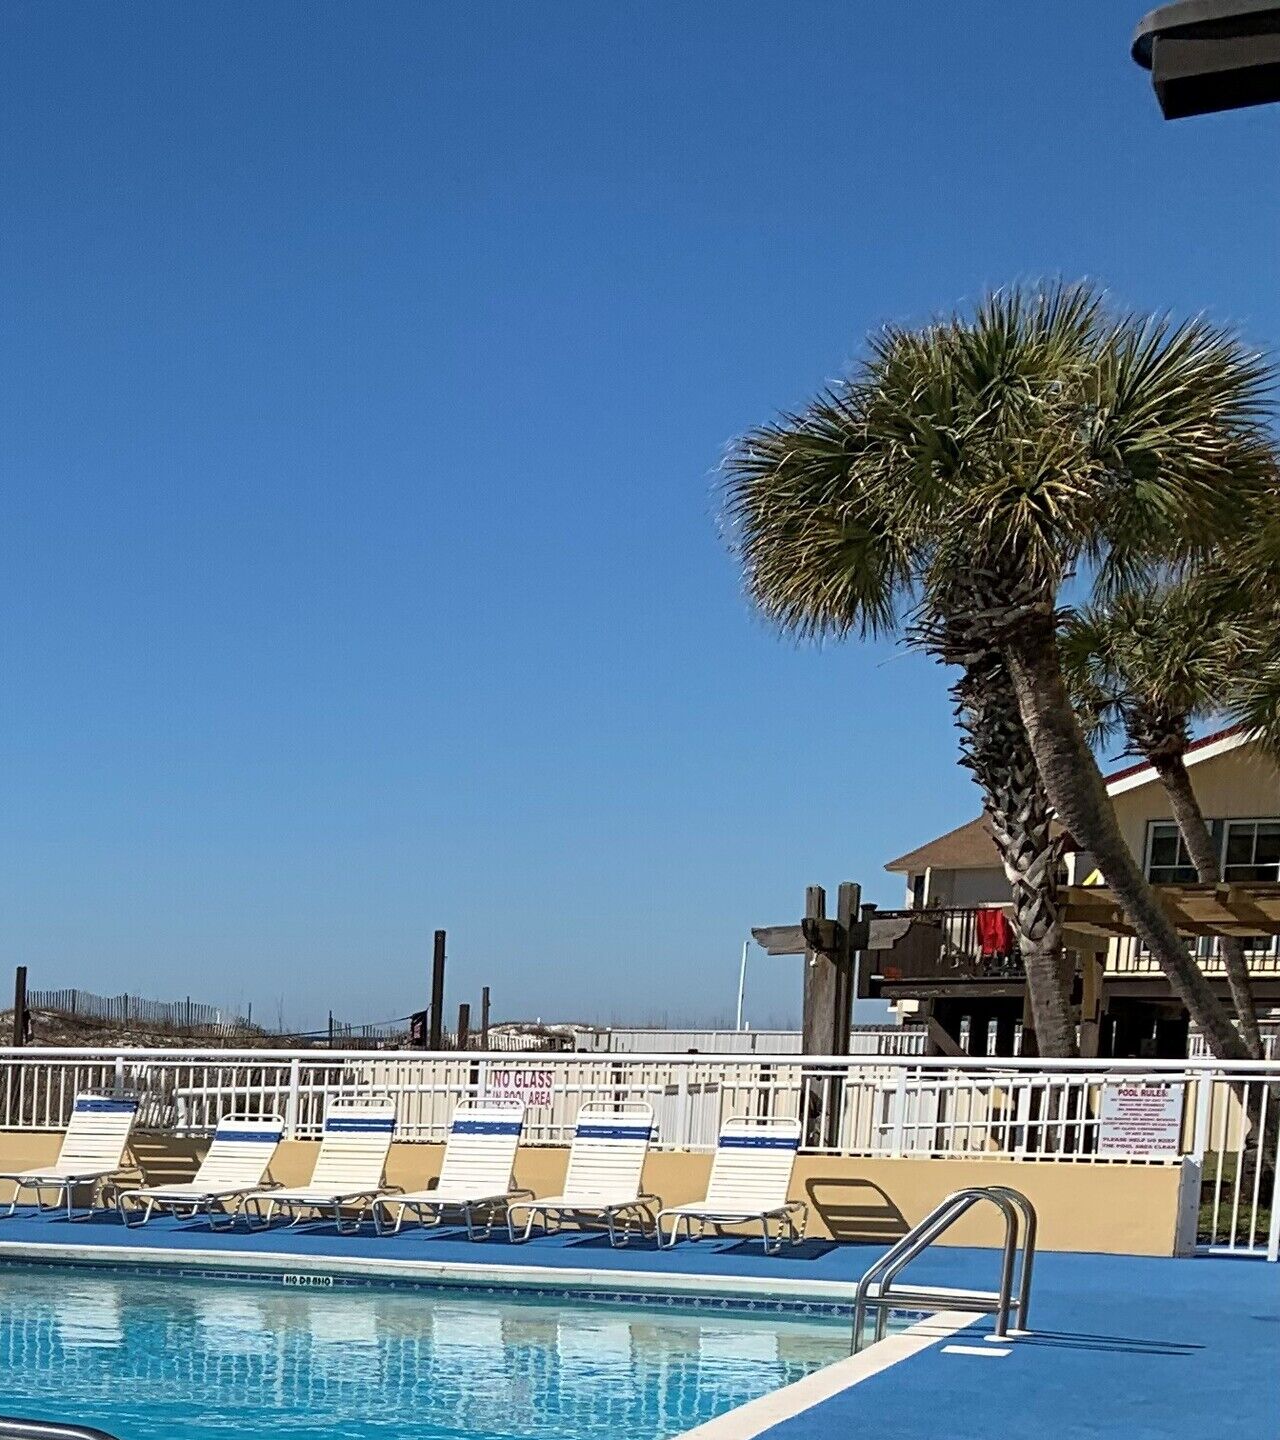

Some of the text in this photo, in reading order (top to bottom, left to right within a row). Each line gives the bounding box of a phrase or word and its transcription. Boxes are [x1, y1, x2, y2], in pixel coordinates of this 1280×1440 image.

[494, 1071, 552, 1088] NO GLASS
[528, 1091, 551, 1105] AREA
[1118, 1089, 1138, 1097] POOL
